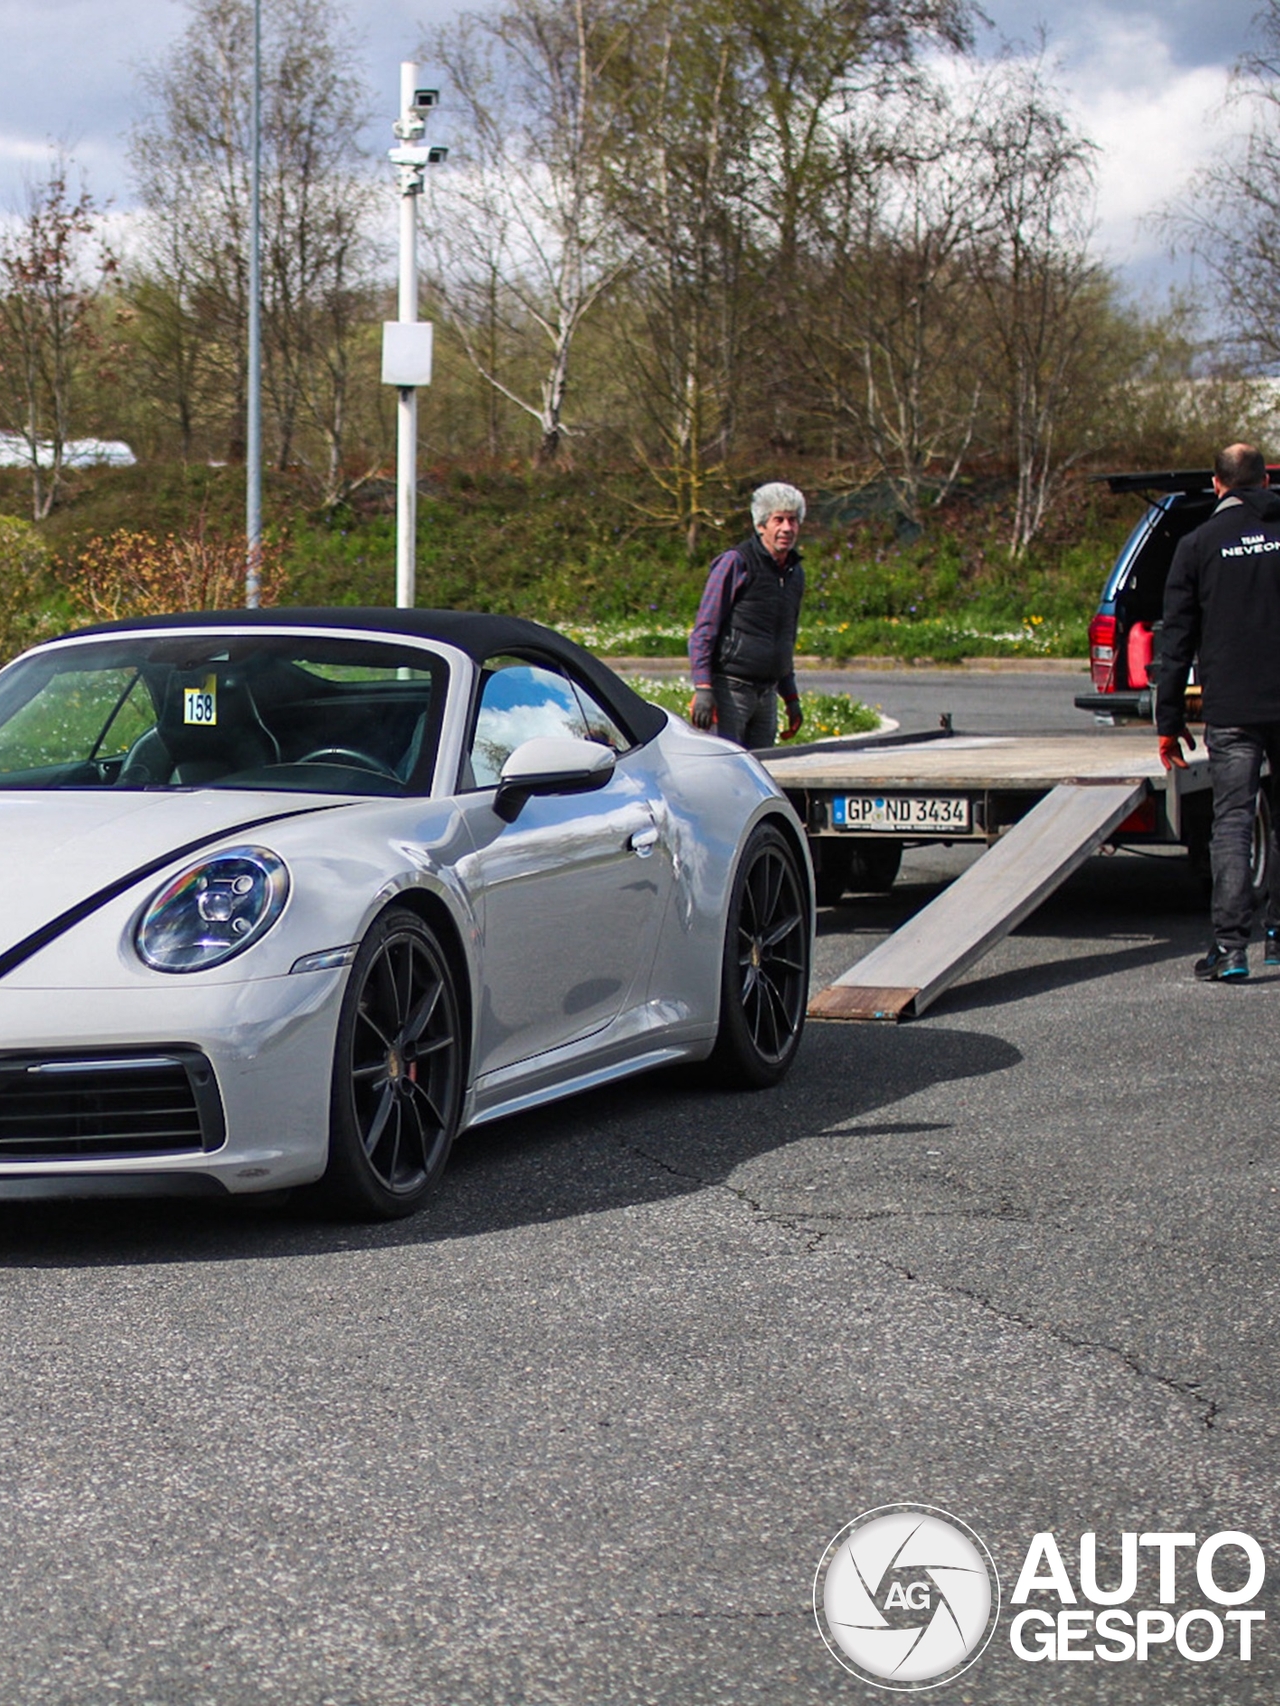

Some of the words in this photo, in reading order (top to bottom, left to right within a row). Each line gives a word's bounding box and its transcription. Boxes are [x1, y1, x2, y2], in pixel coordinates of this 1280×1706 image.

[1241, 534, 1265, 545] TEAM
[188, 694, 213, 721] 158
[848, 799, 873, 820] GP
[886, 799, 911, 821] ND
[916, 800, 963, 822] 3434
